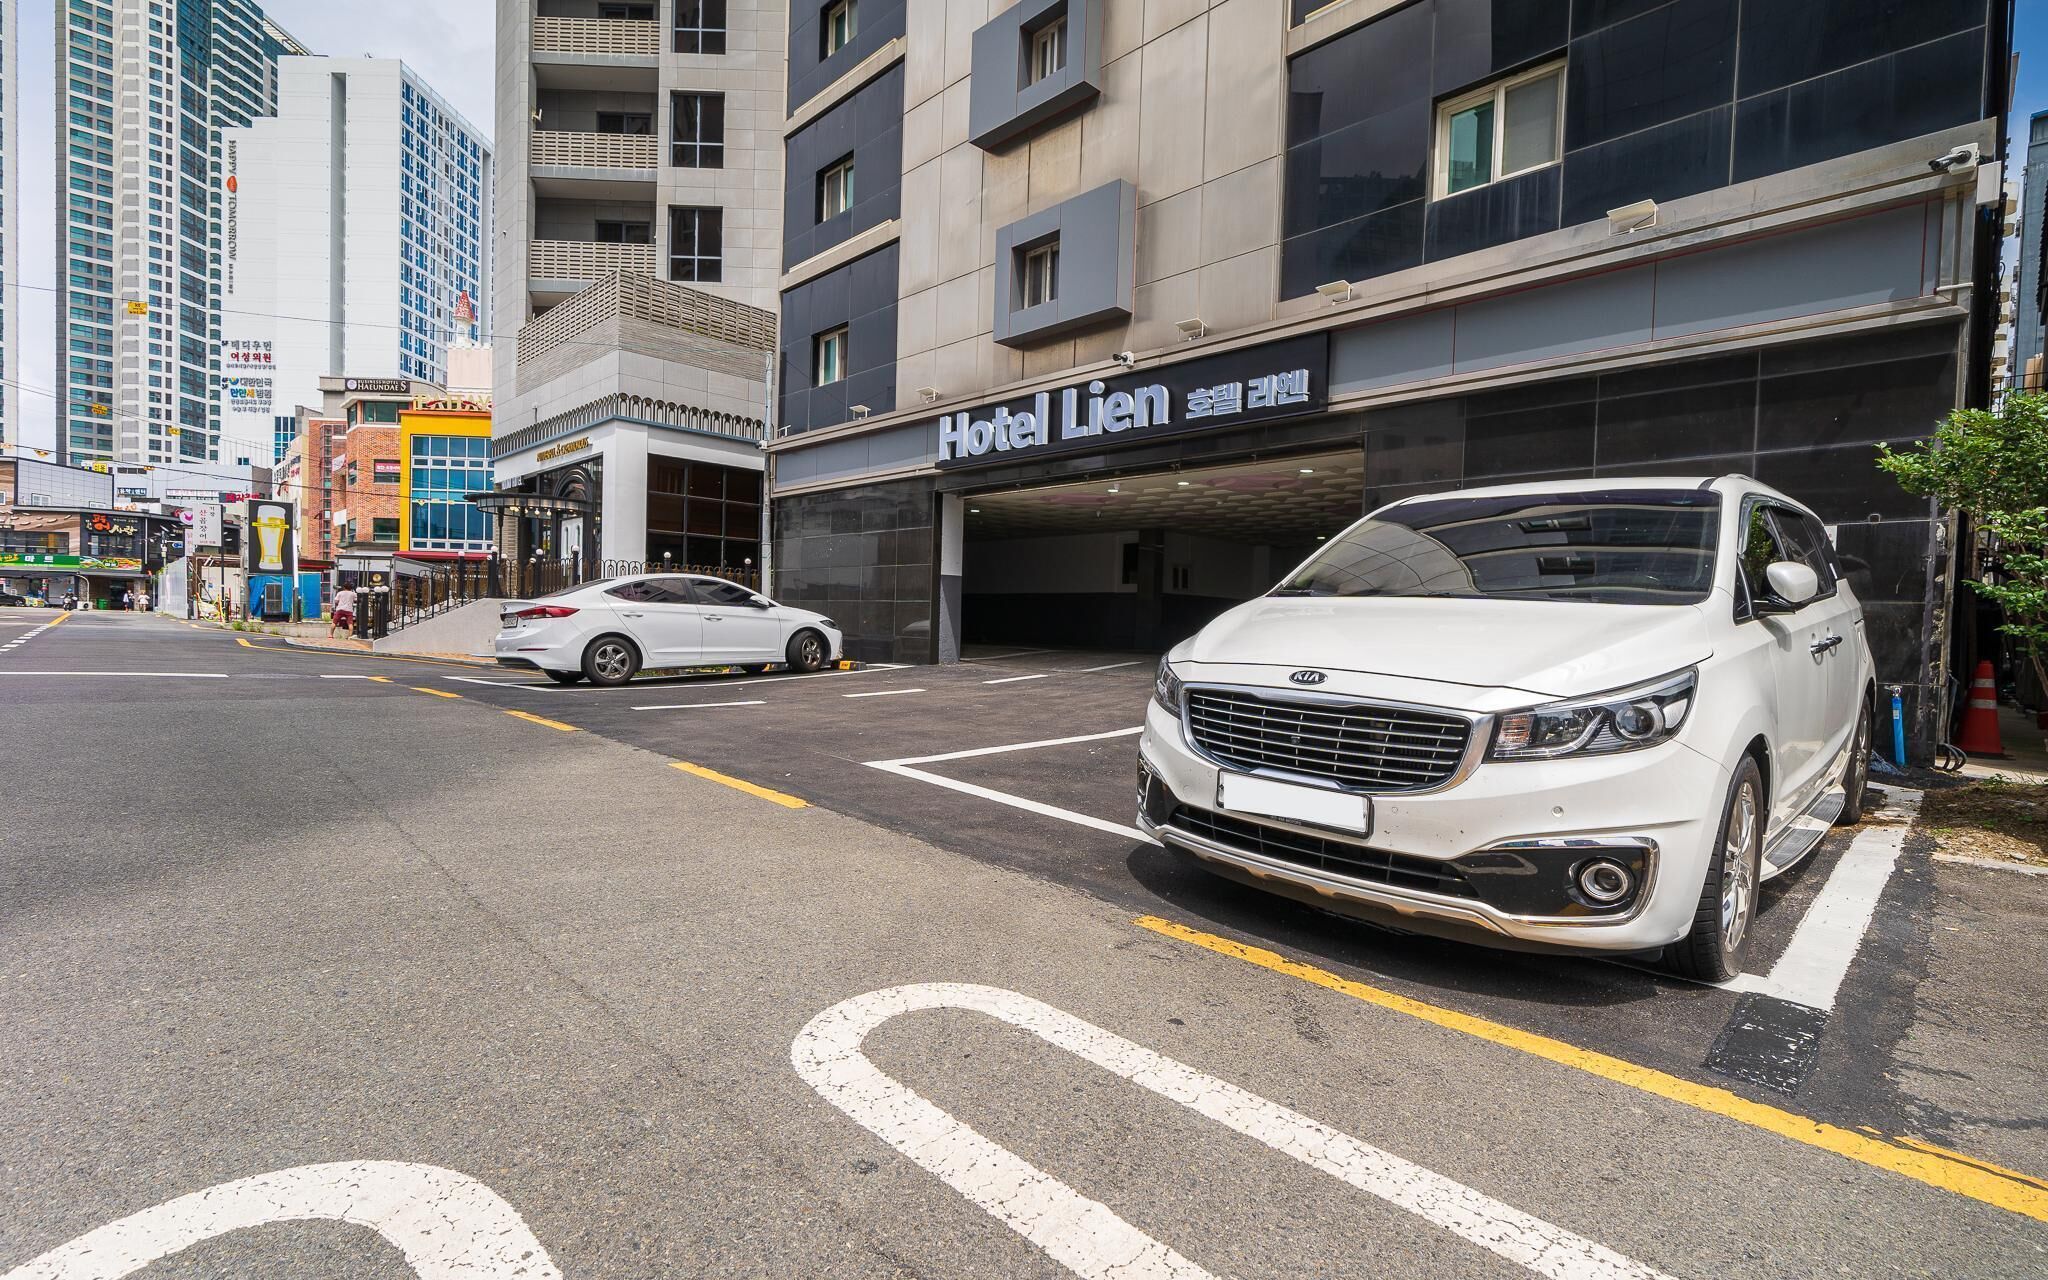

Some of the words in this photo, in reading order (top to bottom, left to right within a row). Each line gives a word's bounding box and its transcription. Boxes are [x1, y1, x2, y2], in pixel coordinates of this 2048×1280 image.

[228, 194, 237, 261] TOMORROW
[230, 351, 272, 363] 여성의원
[240, 376, 273, 388] 대한민국
[357, 383, 399, 392] HAEUNDAE
[400, 380, 407, 392] S
[1185, 381, 1243, 420] 호텔
[1247, 368, 1311, 410] 리엔
[938, 392, 1049, 461] Hotel
[1062, 380, 1169, 440] Lien
[1293, 671, 1320, 682] KIA
